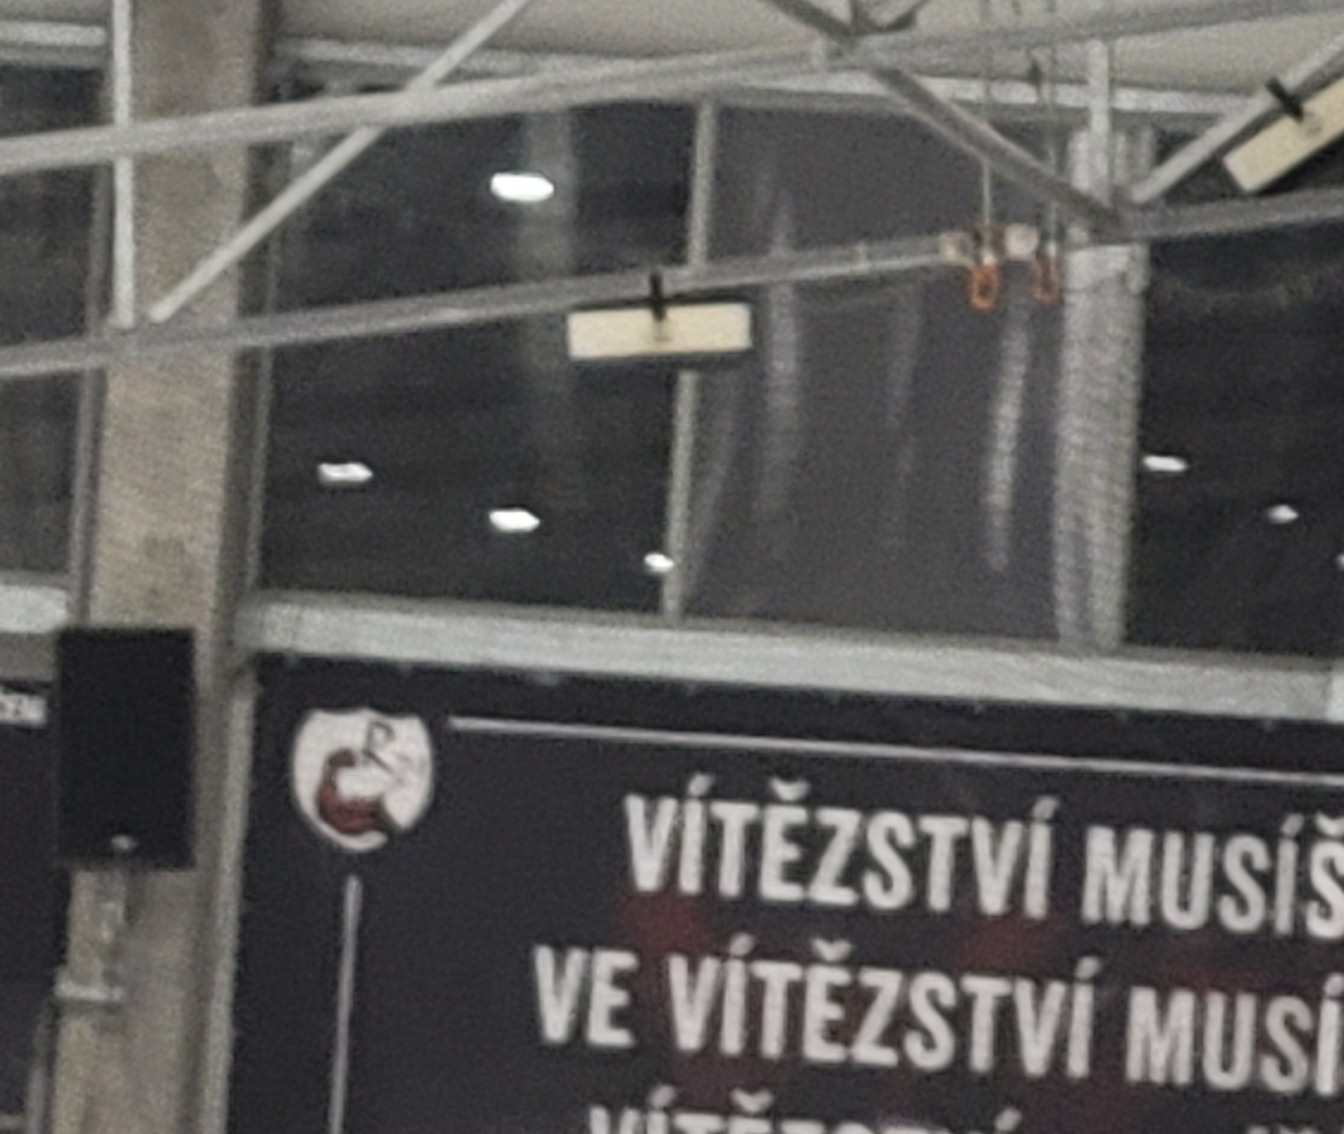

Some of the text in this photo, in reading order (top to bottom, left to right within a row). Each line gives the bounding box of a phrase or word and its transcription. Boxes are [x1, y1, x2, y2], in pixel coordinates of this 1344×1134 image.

[624, 773, 1061, 921] VÍTĚZSTVÍ
[534, 945, 640, 1048] VE
[668, 932, 1102, 1080] VÍTĚZSTVÍ
